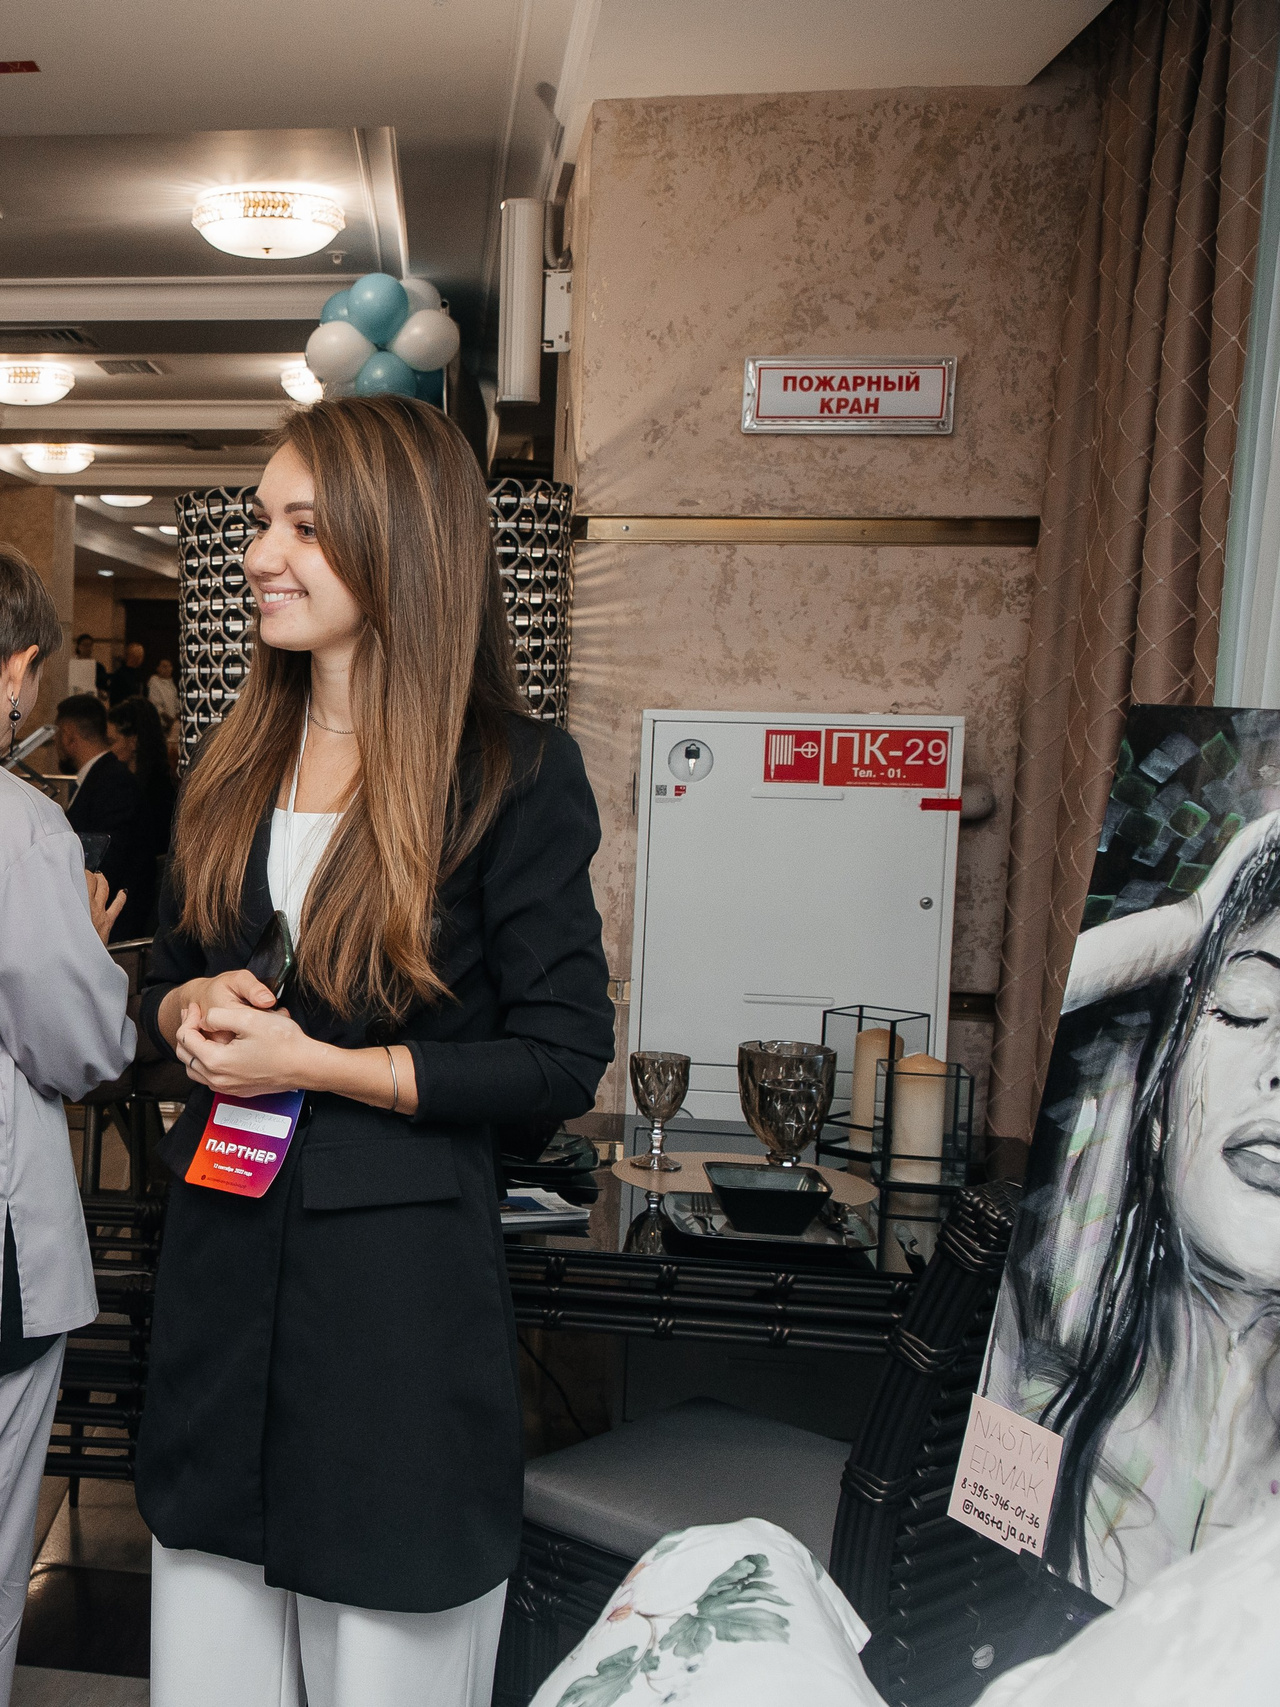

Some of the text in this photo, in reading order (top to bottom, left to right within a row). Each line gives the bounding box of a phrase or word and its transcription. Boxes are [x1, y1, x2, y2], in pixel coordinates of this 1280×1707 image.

[782, 371, 921, 392] ПОЖАРНЫЙ
[819, 397, 880, 414] КРАН
[831, 732, 947, 766] ПК-29
[852, 767, 876, 778] Тел.
[205, 1138, 277, 1165] ПАРТНЕР
[974, 1410, 1050, 1471] NASTYA
[970, 1444, 1044, 1504] ERMAK
